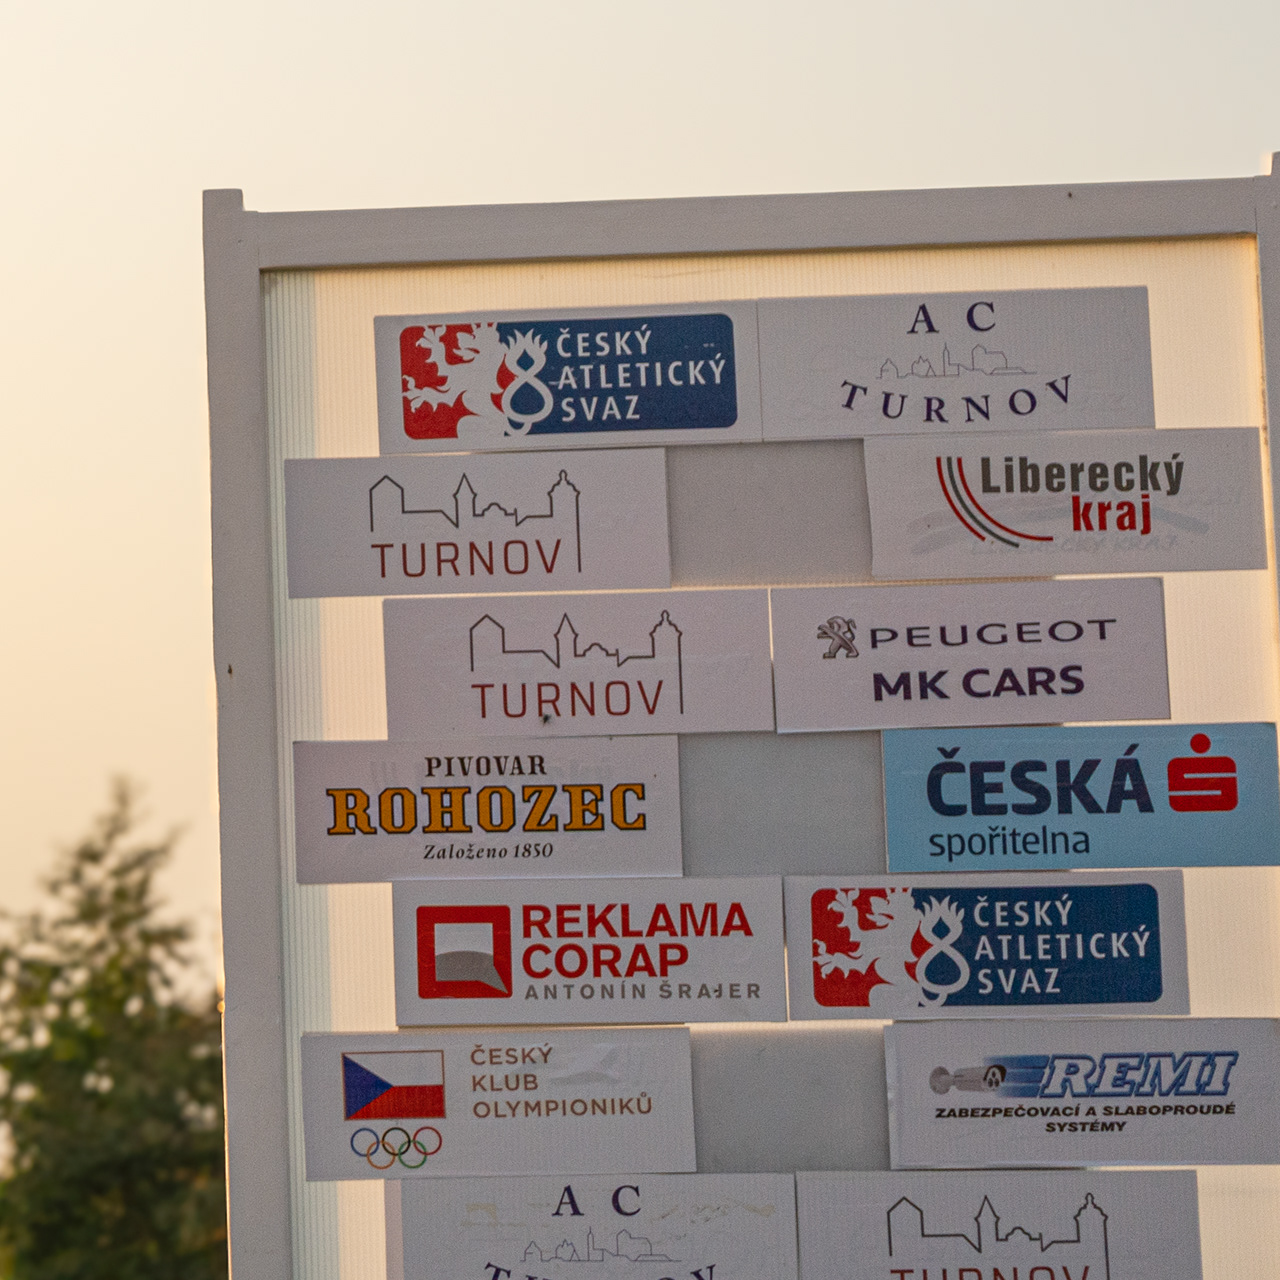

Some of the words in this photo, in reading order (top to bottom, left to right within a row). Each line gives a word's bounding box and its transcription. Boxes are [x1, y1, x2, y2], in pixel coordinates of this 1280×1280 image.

[556, 323, 652, 358] ČESKÝ
[557, 353, 727, 391] ATLETICKÝ
[560, 394, 642, 422] SVAZ
[840, 374, 1073, 423] TURNOV
[981, 452, 1185, 496] Liberecký
[1071, 493, 1152, 535] kraj
[370, 538, 562, 578] TURNOV
[870, 618, 1117, 649] PEUGEOT
[470, 679, 664, 719] TURNOV
[873, 670, 950, 702] MK
[962, 664, 1086, 699] CARS
[425, 754, 548, 778] PIVOVAR
[926, 743, 1156, 817] ČESKÁ
[326, 782, 647, 835] ROHOZEC
[423, 843, 508, 860] Založeno
[513, 842, 554, 859] 1850
[928, 824, 1091, 863] spořitelna
[521, 901, 754, 940] REKLAMA
[973, 893, 1074, 928] ČESKÝ
[521, 943, 690, 979] CORAP
[974, 924, 1151, 962] ATLETICKÝ
[524, 978, 647, 1001] ANTONÍN
[977, 966, 1062, 995] SVAZ
[470, 1042, 554, 1067] ČESKÝ
[472, 1073, 539, 1092] KLUB
[1039, 1050, 1240, 1099] REMI
[473, 1091, 653, 1119] OLYMPIONIKŮ
[935, 1102, 1082, 1119] ZABEZPEČOVACÍ
[1085, 1105, 1098, 1117] A
[1102, 1100, 1236, 1117] SLABOPROUDÉ
[1045, 1119, 1127, 1134] SYSTÉMY
